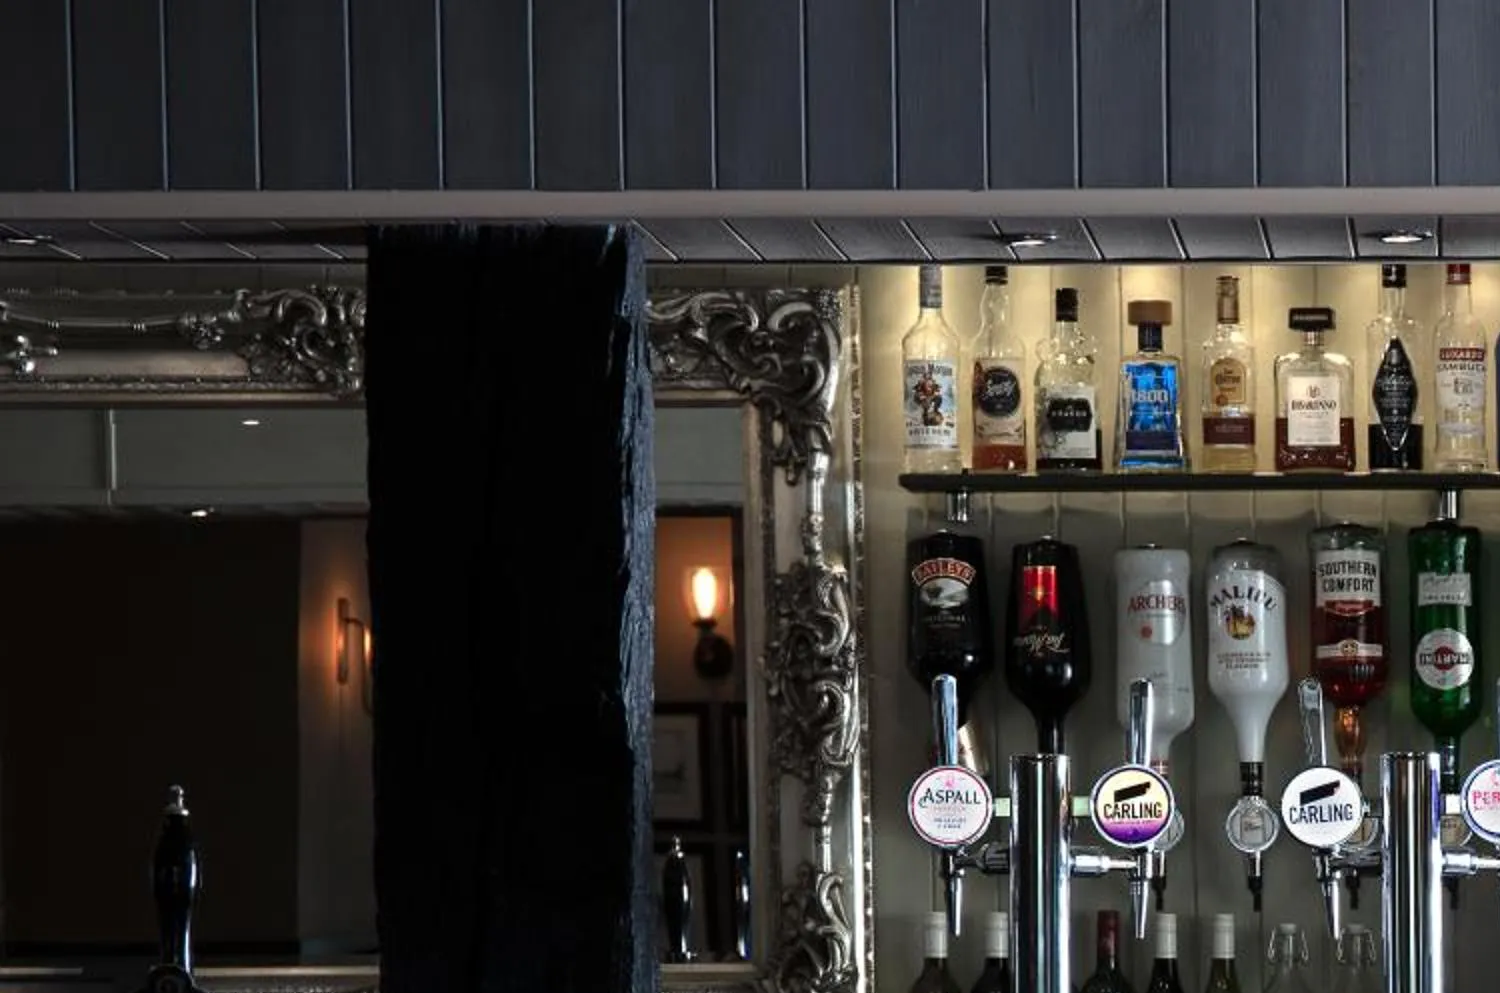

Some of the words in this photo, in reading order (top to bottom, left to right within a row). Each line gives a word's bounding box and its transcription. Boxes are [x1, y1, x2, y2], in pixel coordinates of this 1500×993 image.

[1319, 560, 1377, 577] SOUTHERN
[1322, 577, 1375, 593] COMFORT
[1129, 594, 1186, 612] ARCHERS
[1418, 652, 1470, 666] MARTINI
[918, 787, 981, 809] ASPALL
[1103, 802, 1163, 819] CARLING
[1289, 802, 1354, 825] CARLING
